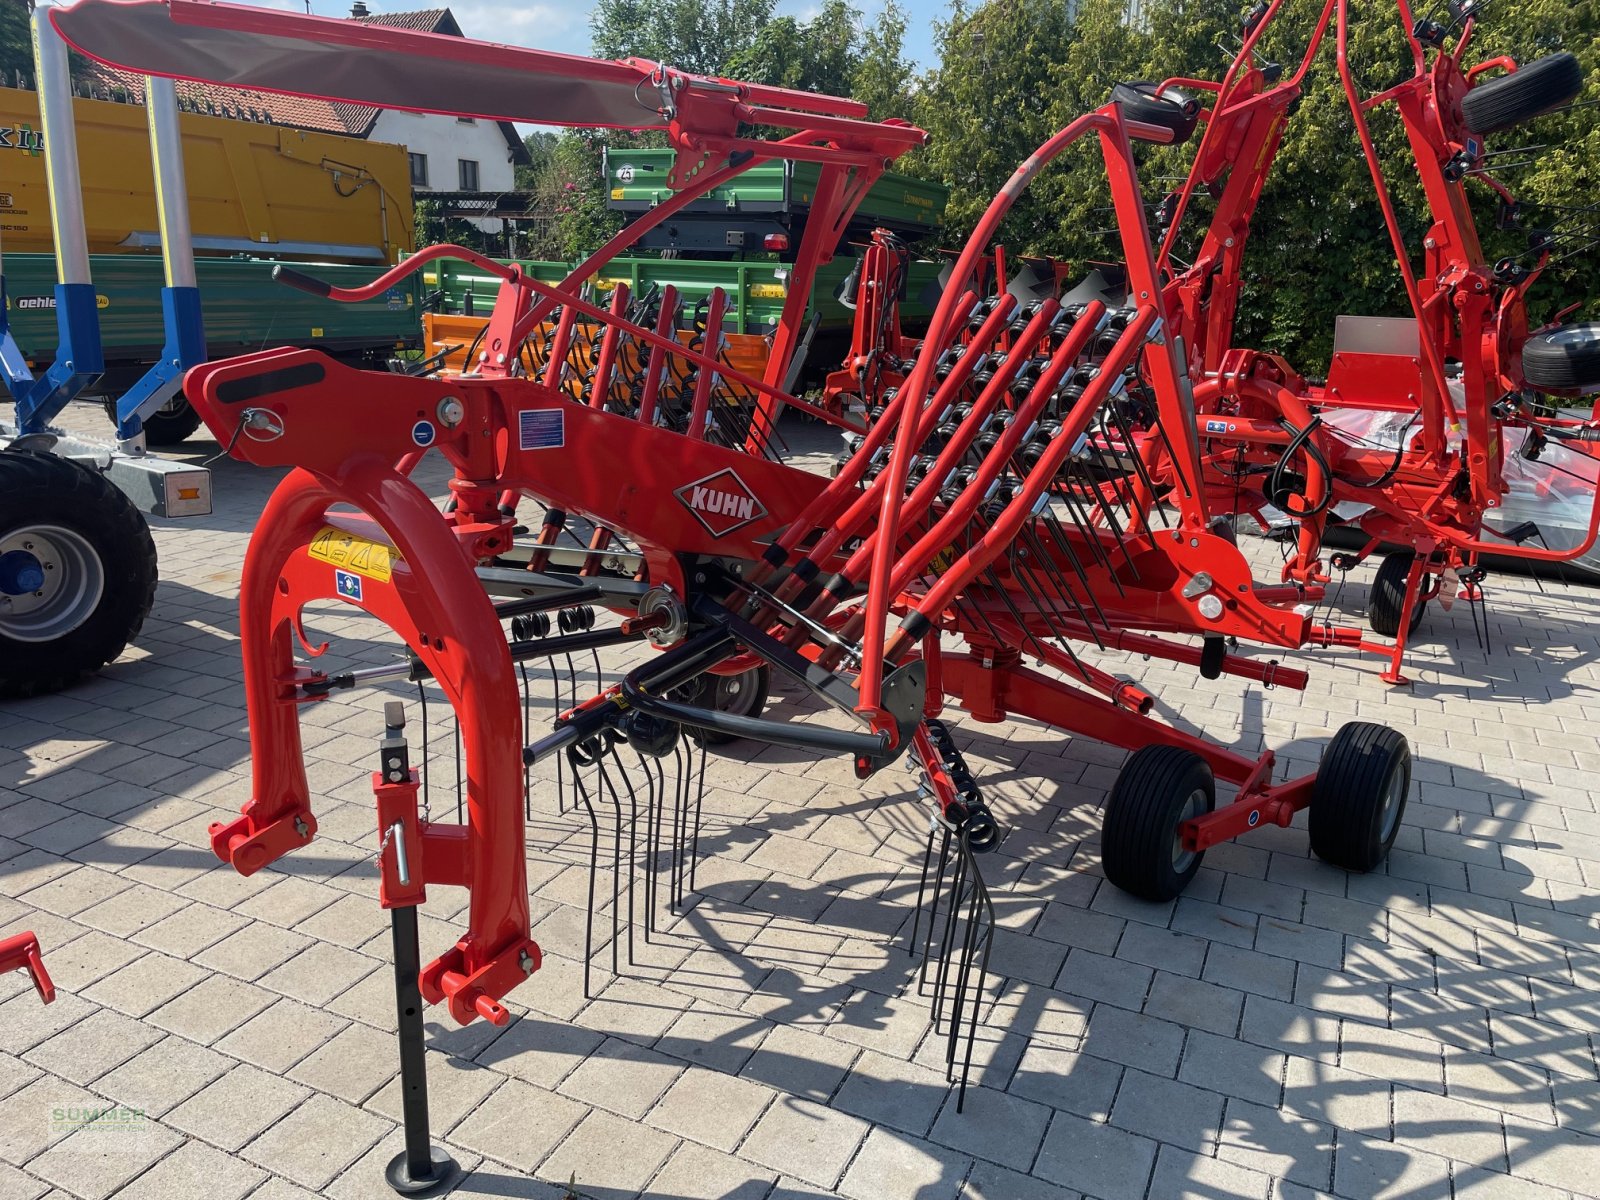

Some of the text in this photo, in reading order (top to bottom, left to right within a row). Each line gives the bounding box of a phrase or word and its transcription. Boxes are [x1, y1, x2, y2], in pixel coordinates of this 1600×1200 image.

[620, 167, 631, 180] 25
[19, 297, 57, 308] oehle
[690, 485, 754, 519] KUHN
